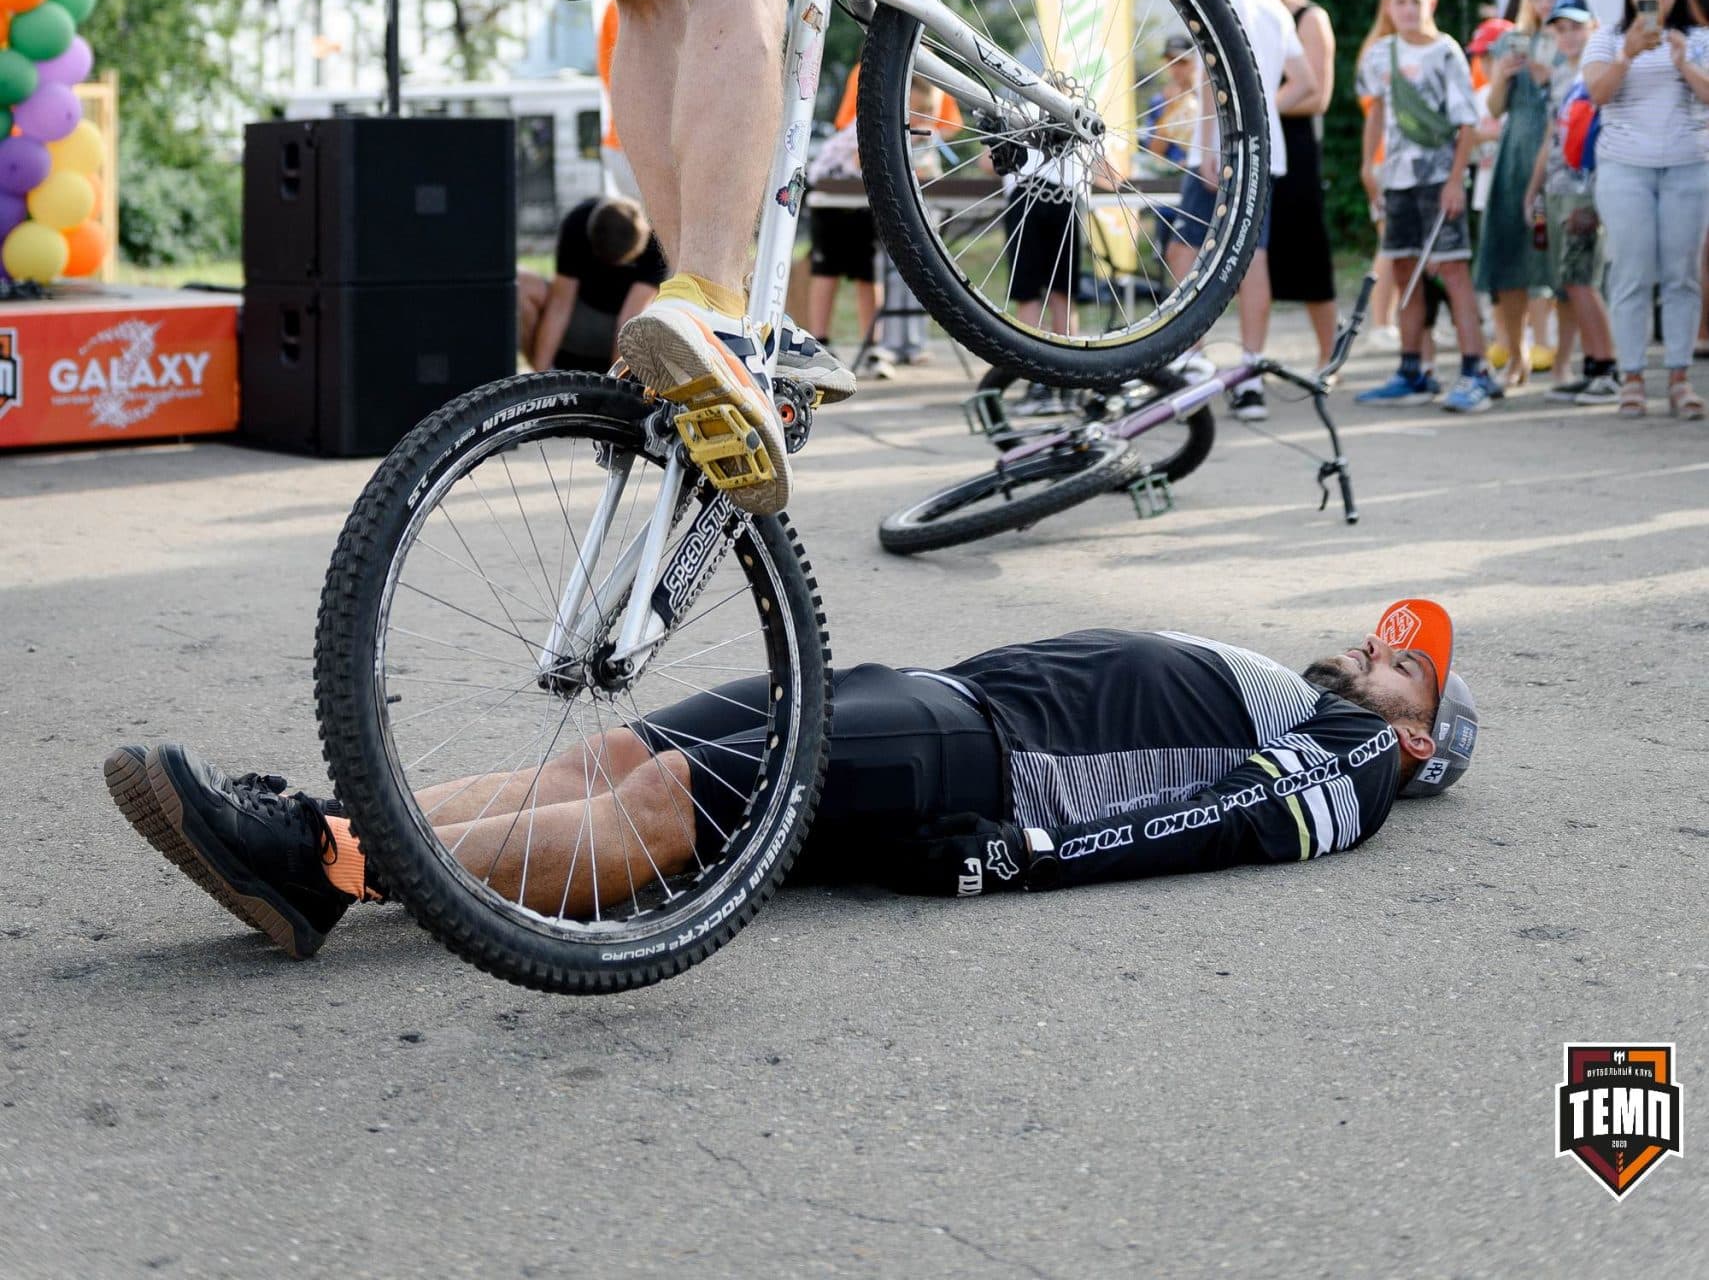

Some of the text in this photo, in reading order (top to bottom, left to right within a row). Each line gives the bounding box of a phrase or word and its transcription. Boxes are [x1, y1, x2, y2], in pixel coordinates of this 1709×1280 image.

[1246, 153, 1260, 217] MICHELIN
[49, 352, 209, 393] GALAXY
[482, 398, 558, 433] MICHELIN
[1273, 757, 1341, 797] YOKO
[1144, 805, 1221, 839] YOKO
[748, 805, 798, 891] MICHELIN
[1059, 824, 1134, 860] YOKO
[601, 942, 666, 962] ENDURO
